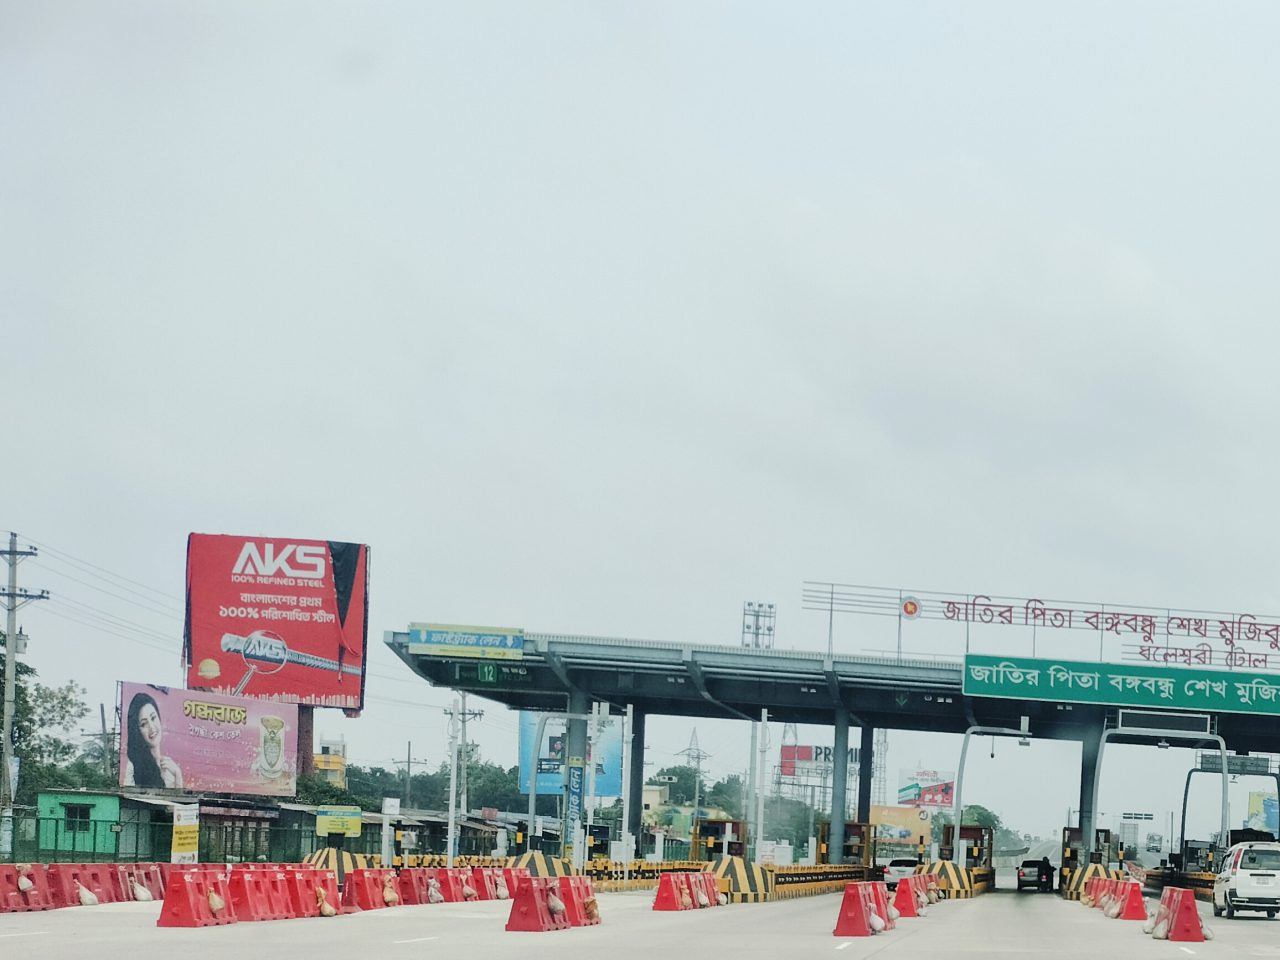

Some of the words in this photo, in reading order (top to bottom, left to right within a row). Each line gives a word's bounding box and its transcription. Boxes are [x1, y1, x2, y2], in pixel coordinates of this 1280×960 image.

[232, 541, 326, 579] AKS
[231, 574, 255, 584] 100%
[256, 576, 295, 587] REFINED
[297, 578, 325, 588] STEEL
[240, 592, 298, 606] বাংলাদেশের
[299, 596, 322, 608] প্রথম
[219, 605, 259, 619] ১০০%
[261, 607, 310, 622] পরিশোধিত
[941, 595, 1013, 625] জাতির
[1024, 599, 1073, 629] পিতা
[1084, 609, 1158, 643] বঙ্গবন্ধু
[1167, 615, 1209, 639] শেখ
[1139, 643, 1212, 666] ধলেশ্বরী
[1226, 647, 1268, 668] টোল
[484, 665, 494, 681] 12
[968, 663, 1040, 687] জাতির
[1049, 664, 1100, 691] পিতা
[1108, 674, 1176, 700] বঙ্গবন্ধু
[1184, 678, 1228, 698] শেখ
[183, 699, 247, 726] গন্ধরাজ
